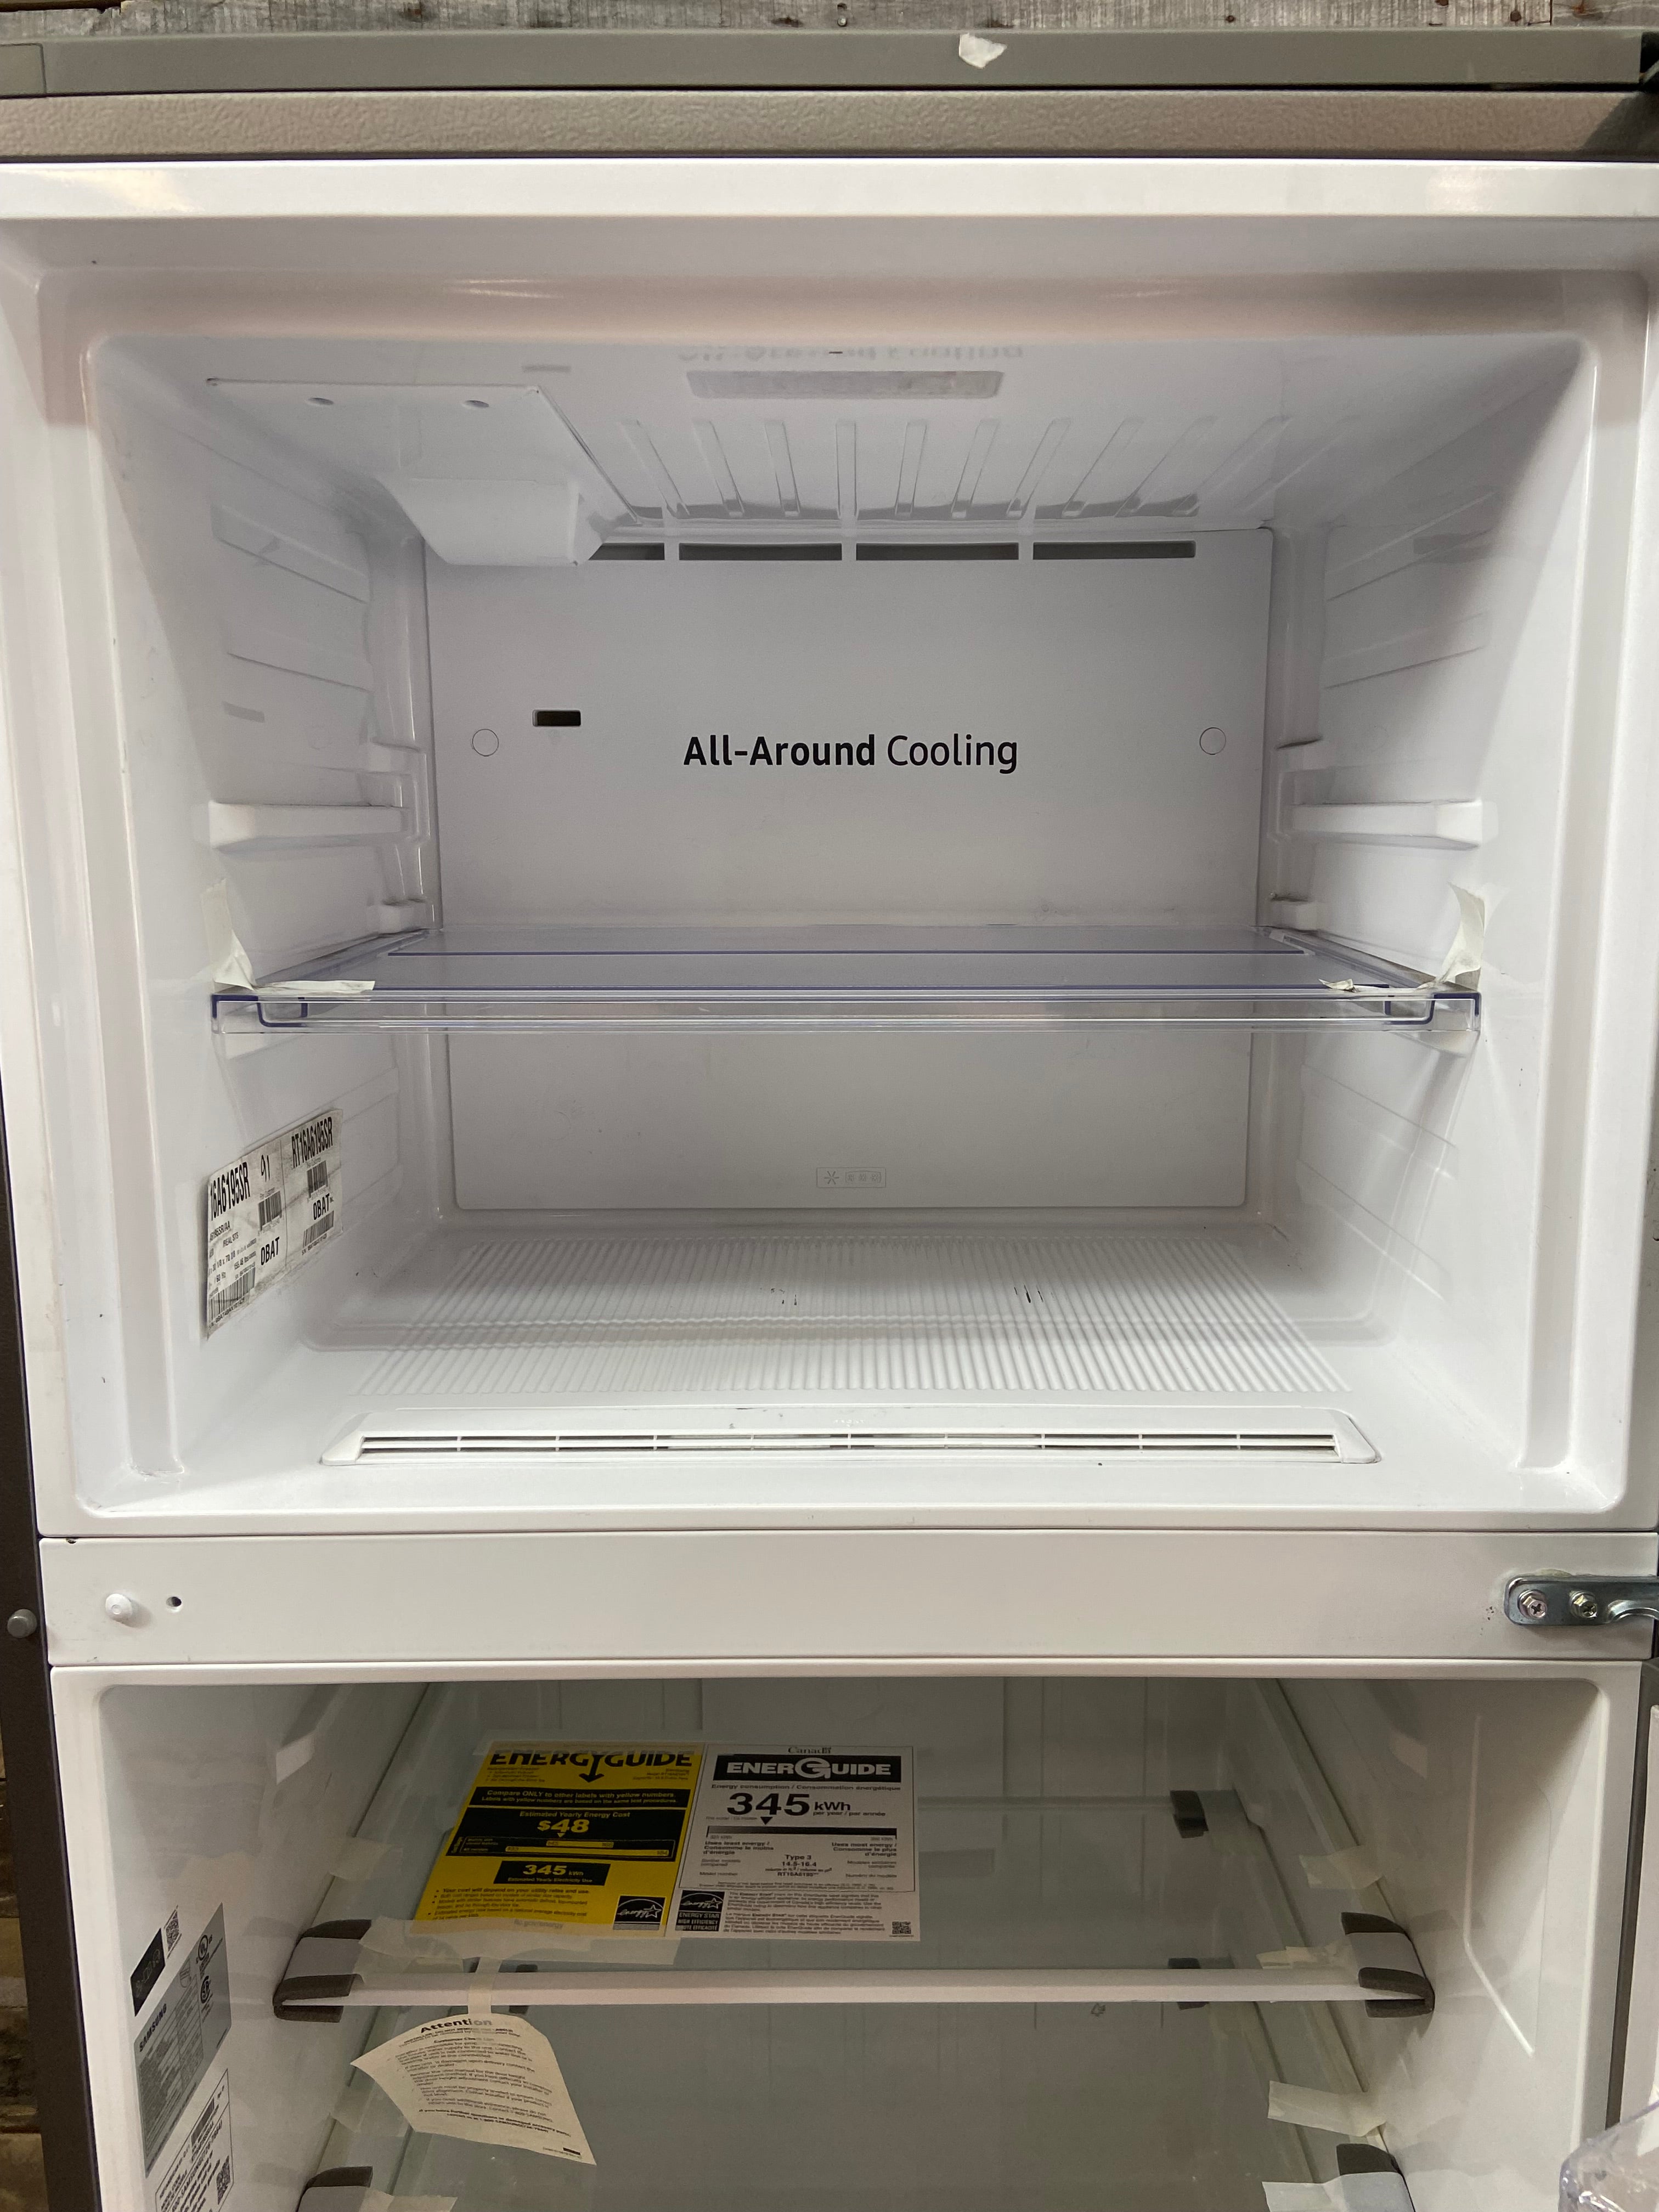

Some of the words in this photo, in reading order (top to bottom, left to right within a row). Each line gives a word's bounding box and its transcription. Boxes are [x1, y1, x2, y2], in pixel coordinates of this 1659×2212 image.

[684, 733, 874, 766] All-Around
[887, 733, 1018, 774] Cooling
[291, 1117, 333, 1168] RT16A6195SR
[727, 1758, 891, 1779] ENERGUIDE
[727, 1793, 810, 1816] 345
[815, 1802, 850, 1810] kWh
[537, 1819, 590, 1833] $48
[522, 1864, 567, 1875] 345
[139, 2004, 167, 2052] SAMSUNG
[421, 2018, 492, 2033] Attention
